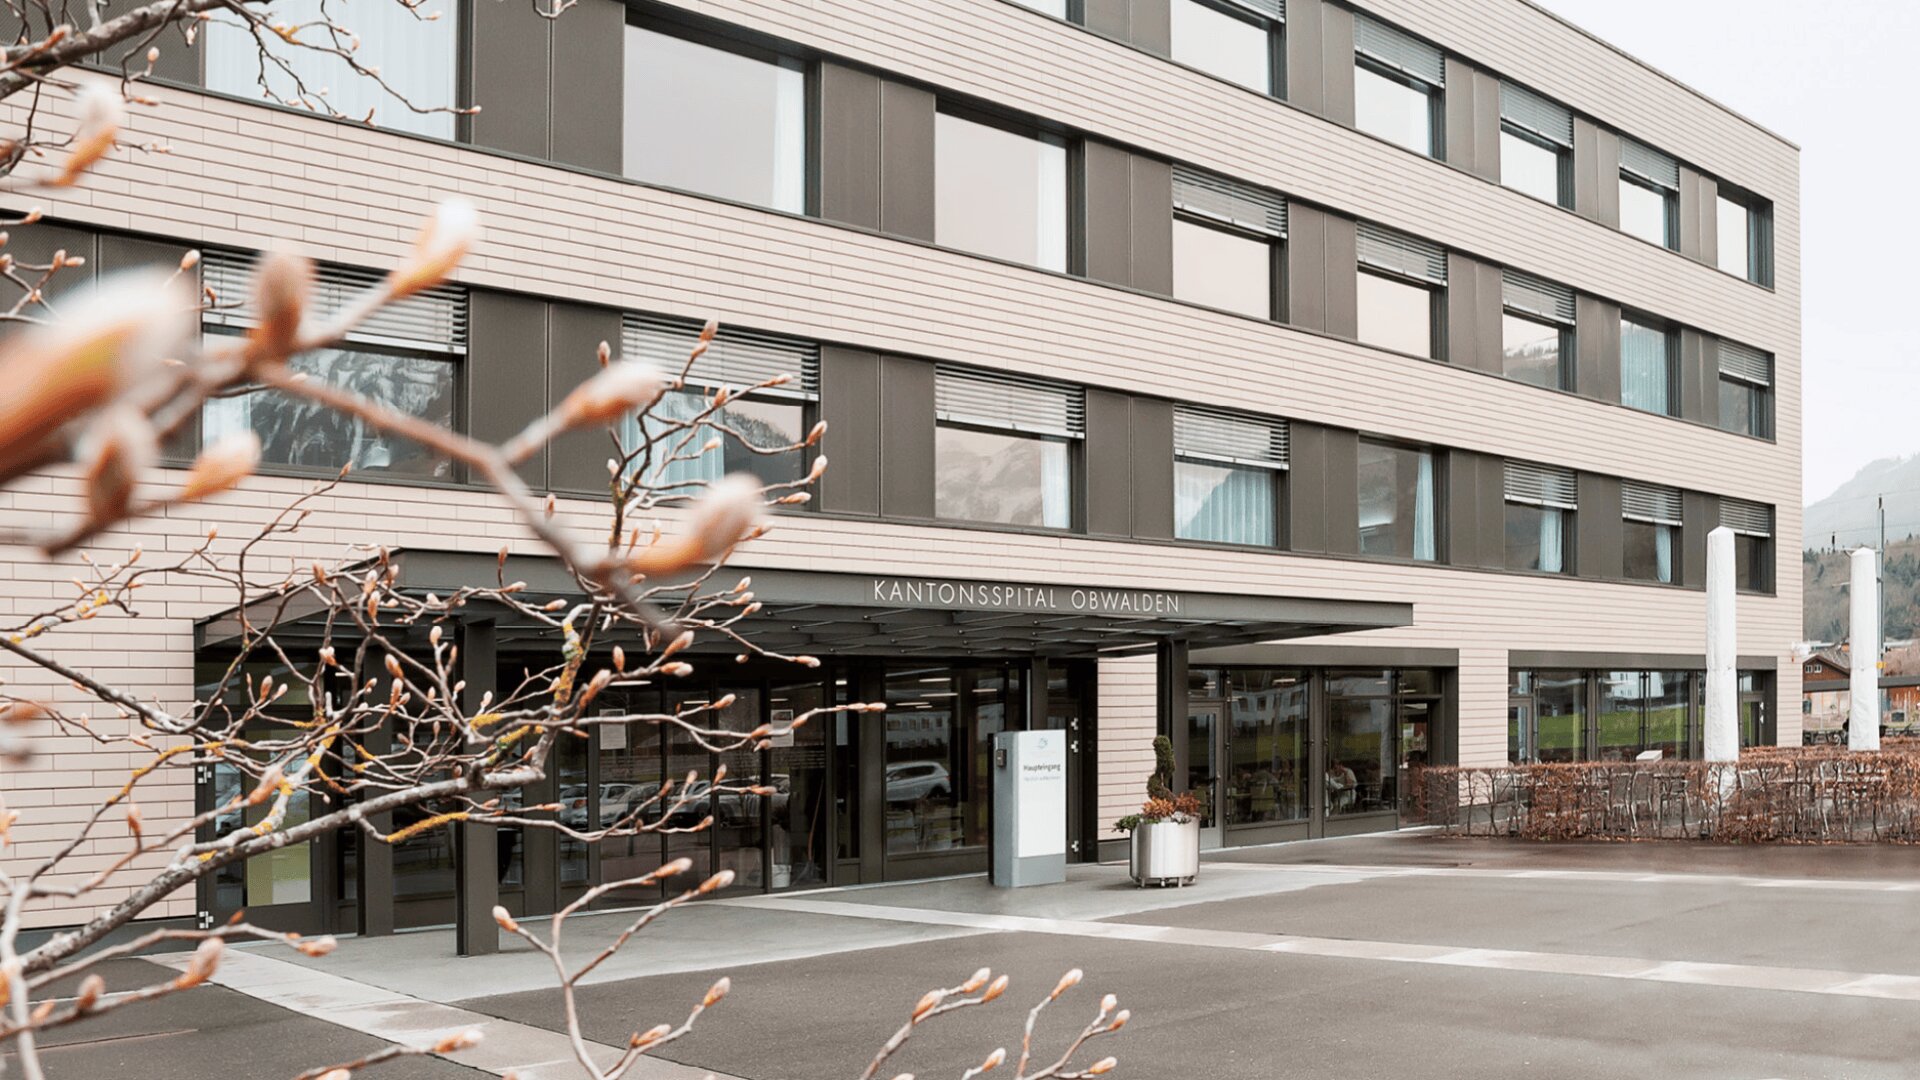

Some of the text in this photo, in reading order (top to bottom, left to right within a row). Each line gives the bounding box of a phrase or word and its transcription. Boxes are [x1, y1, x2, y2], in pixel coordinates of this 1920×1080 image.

[874, 579, 1179, 613] KANTONSSPITAL OBWALDEN
[1023, 763, 1061, 772] Haupteingang
